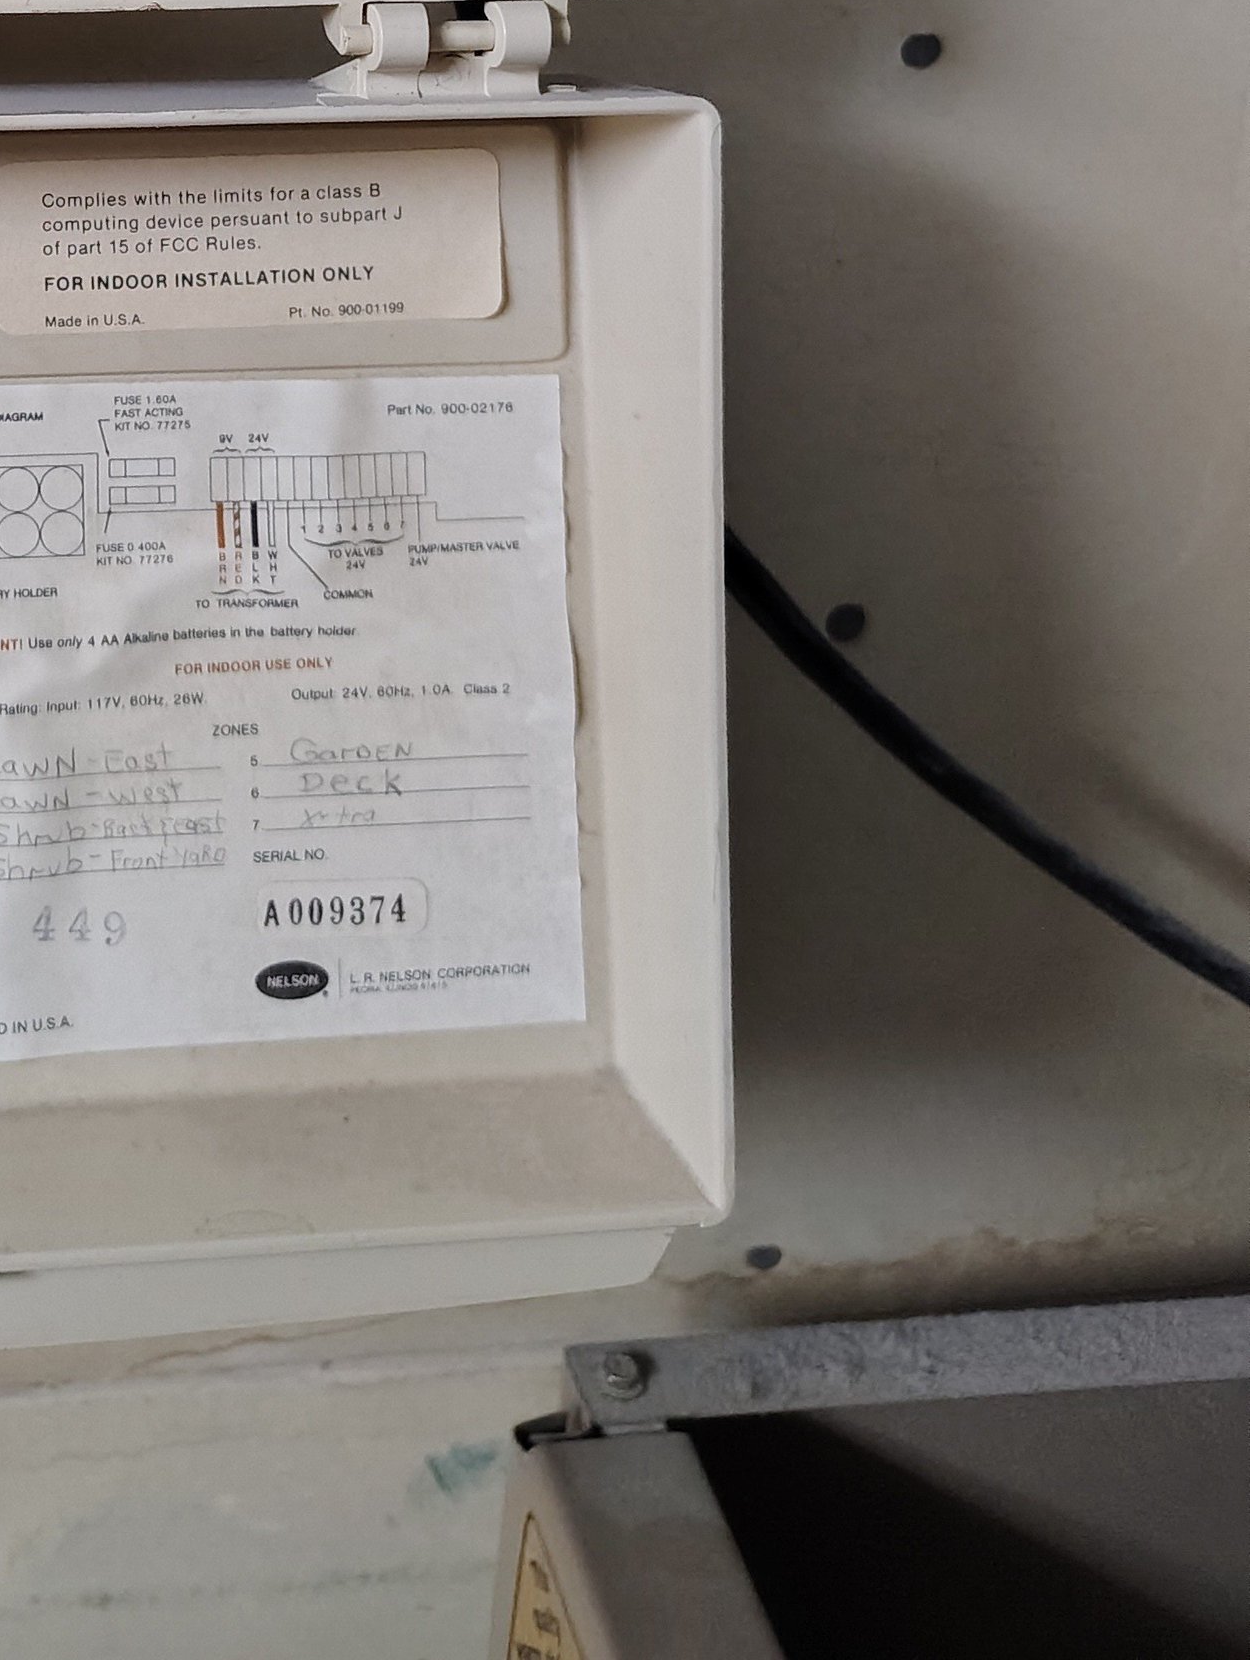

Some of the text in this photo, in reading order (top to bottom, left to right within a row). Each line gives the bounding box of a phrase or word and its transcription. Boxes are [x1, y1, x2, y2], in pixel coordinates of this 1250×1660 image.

[42, 183, 380, 209] Complies with the limits for a class B
[43, 206, 401, 234] computing device persuant to subpart J
[43, 236, 261, 258] of part 15 of FCC Rules.
[45, 266, 373, 291] FOR INDOOR INSTALLATION ONLY
[289, 302, 404, 318] Pt. No. 900-01199
[46, 314, 144, 327] Made in U.S.A.
[388, 402, 513, 415] Part No. 900-02176
[14, 587, 57, 598] HOLDER
[324, 590, 373, 600] COMMON
[29, 638, 52, 649] Use
[57, 636, 82, 649] only
[88, 636, 95, 647] 4
[101, 635, 119, 646] AA
[124, 631, 169, 644] Alkaline
[173, 629, 226, 640] batteries
[231, 627, 240, 637] in
[245, 627, 264, 637] the
[271, 626, 312, 638] battery
[318, 626, 356, 636] holder
[213, 724, 258, 736] ZONES
[253, 848, 328, 863] SERIAL NO.
[264, 894, 405, 926] A009374
[32, 905, 124, 946] 449
[267, 974, 319, 988] NELSON
[380, 968, 430, 982] NELSON
[438, 964, 530, 979] CORPORATION
[13, 1020, 27, 1033] IN
[33, 1016, 74, 1032] U.S.A.
